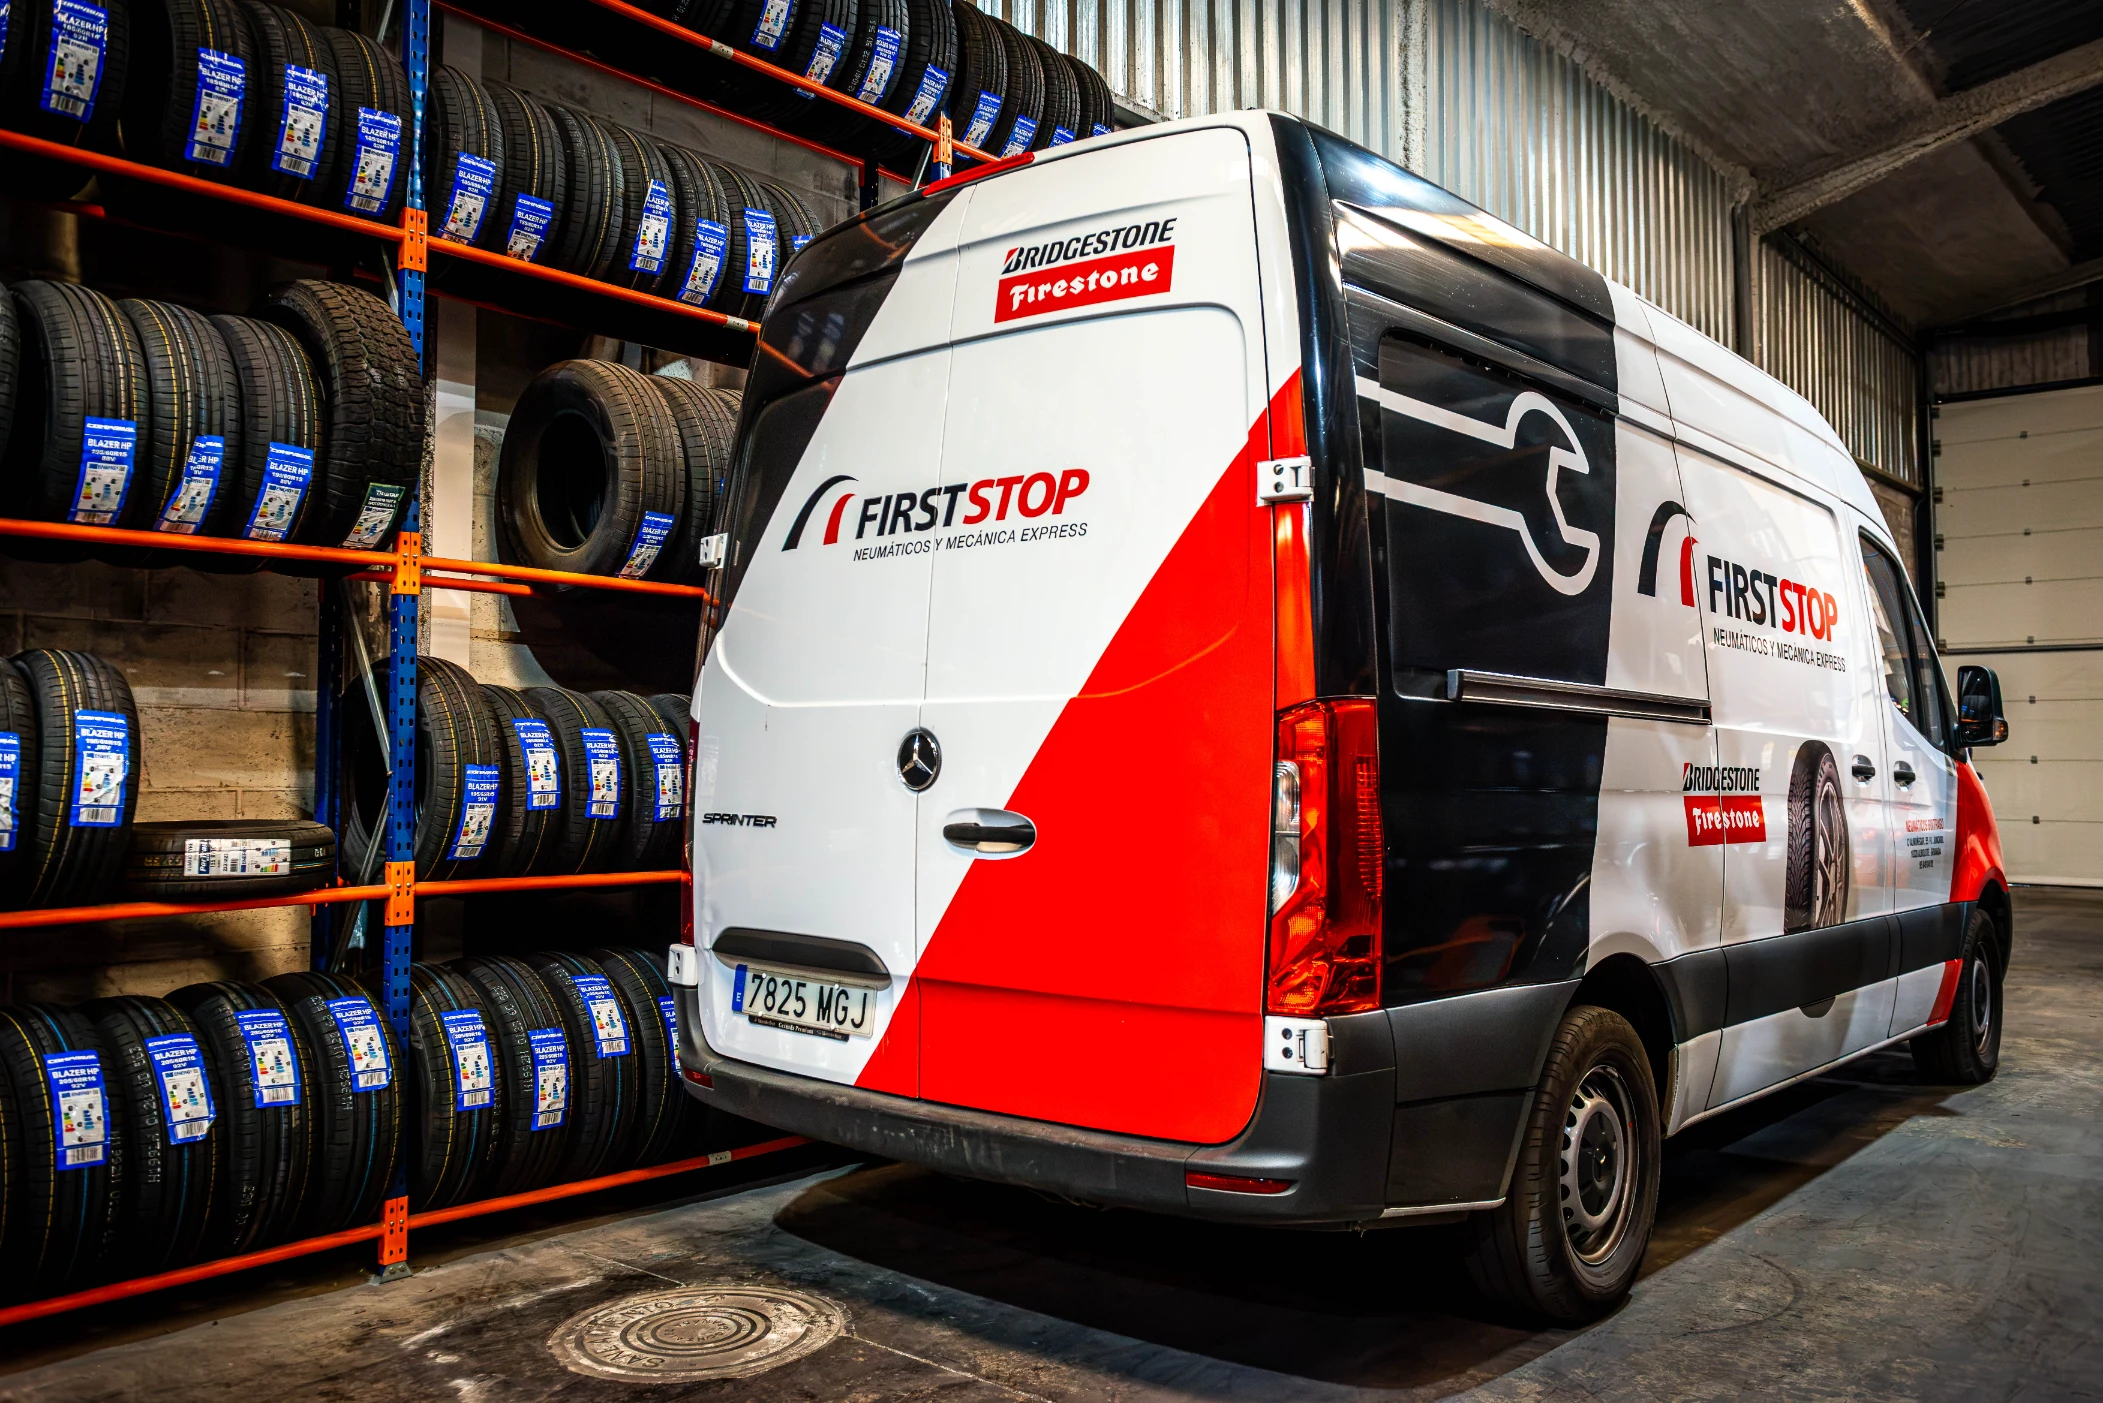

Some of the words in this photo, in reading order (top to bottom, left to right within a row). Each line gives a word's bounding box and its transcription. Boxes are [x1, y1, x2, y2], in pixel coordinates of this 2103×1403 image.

[202, 68, 230, 81] BLAZER
[288, 82, 316, 97] BLAZER
[362, 126, 388, 139] BLAZER
[389, 132, 398, 140] HP
[458, 170, 482, 183] BLAZER
[518, 211, 540, 223] BLAZER
[1001, 218, 1178, 275] BRIDGESTONE
[1010, 262, 1160, 312] Firestone
[88, 438, 120, 449] BLAZER
[121, 442, 132, 450] HP
[270, 462, 297, 475] BLAZER
[298, 467, 309, 476] HP
[856, 469, 1090, 539] FIRSTSTOP
[854, 539, 931, 562] NEUMÁTICOS
[934, 538, 943, 551] Y
[946, 530, 1015, 550] MECÁNICA
[1020, 523, 1088, 543] EXPRESS
[1707, 554, 1838, 642] FIRSTSTOP
[1714, 628, 1768, 656] NEUMÁTICOS
[1770, 641, 1775, 657] Y
[1777, 642, 1816, 666] MECÁNICA
[1816, 652, 1846, 673] EXPRESS
[80, 728, 113, 739] BLAZER
[114, 732, 126, 740] HP
[1682, 763, 1760, 792] BRIDGESTONE
[468, 783, 490, 791] BLAZER
[702, 812, 777, 828] SPRINTER
[1693, 808, 1760, 835] Firestone
[736, 992, 742, 1002] E
[748, 974, 807, 1018] 7825
[816, 986, 868, 1029] MGJ
[336, 1010, 362, 1019] BLAZER
[244, 1023, 274, 1031] BLAZER
[450, 1026, 474, 1034] BLAZER
[154, 1050, 185, 1060] BLAZER
[535, 1046, 557, 1054] BLAZER
[52, 1068, 87, 1079] BLAZER
